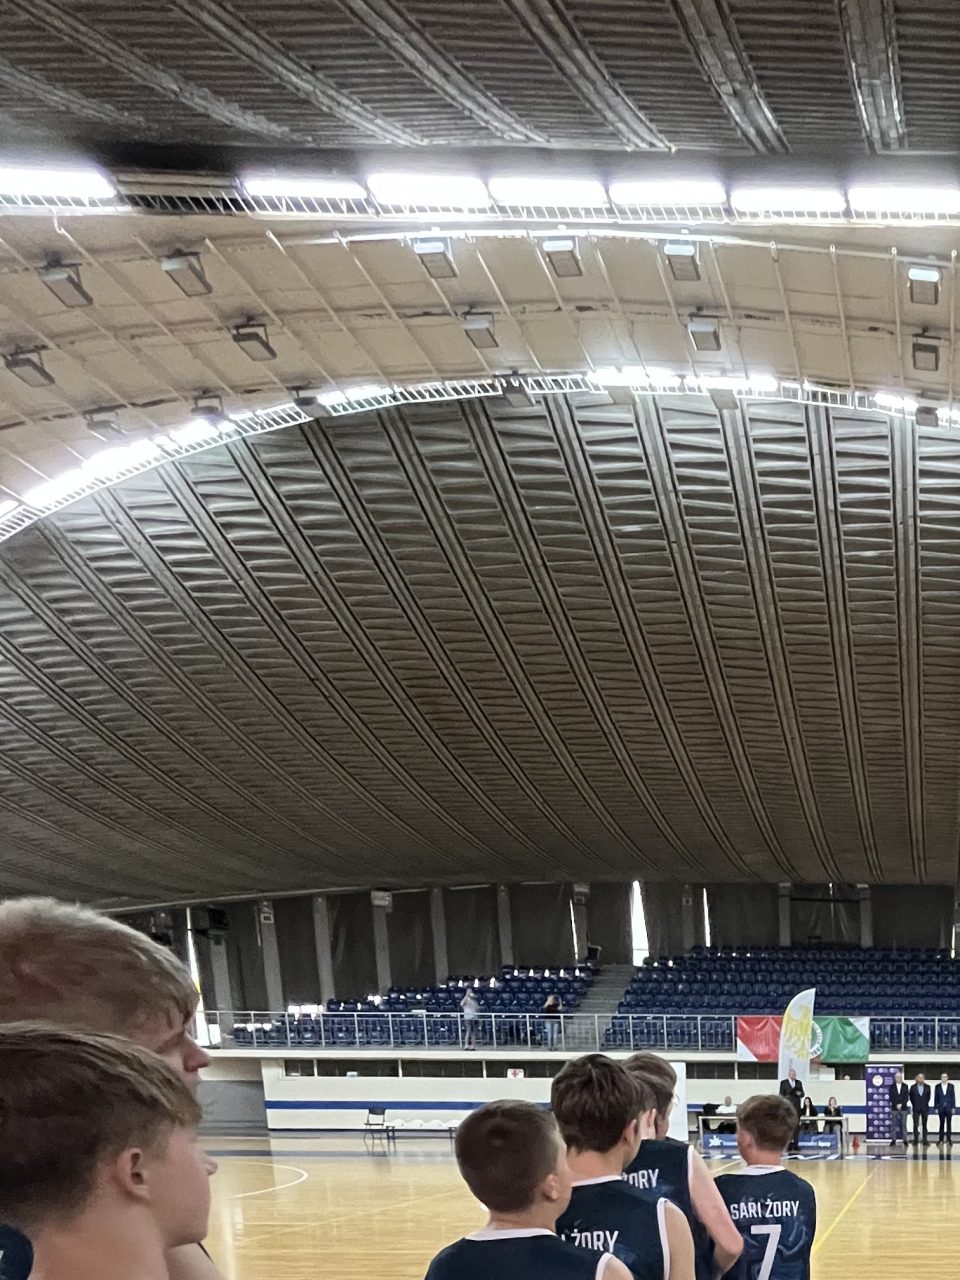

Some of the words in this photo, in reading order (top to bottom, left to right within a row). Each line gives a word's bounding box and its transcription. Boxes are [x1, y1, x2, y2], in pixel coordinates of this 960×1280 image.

[622, 1168, 659, 1189] ORY
[730, 1202, 762, 1220] SARI
[765, 1198, 800, 1218] ŻORY
